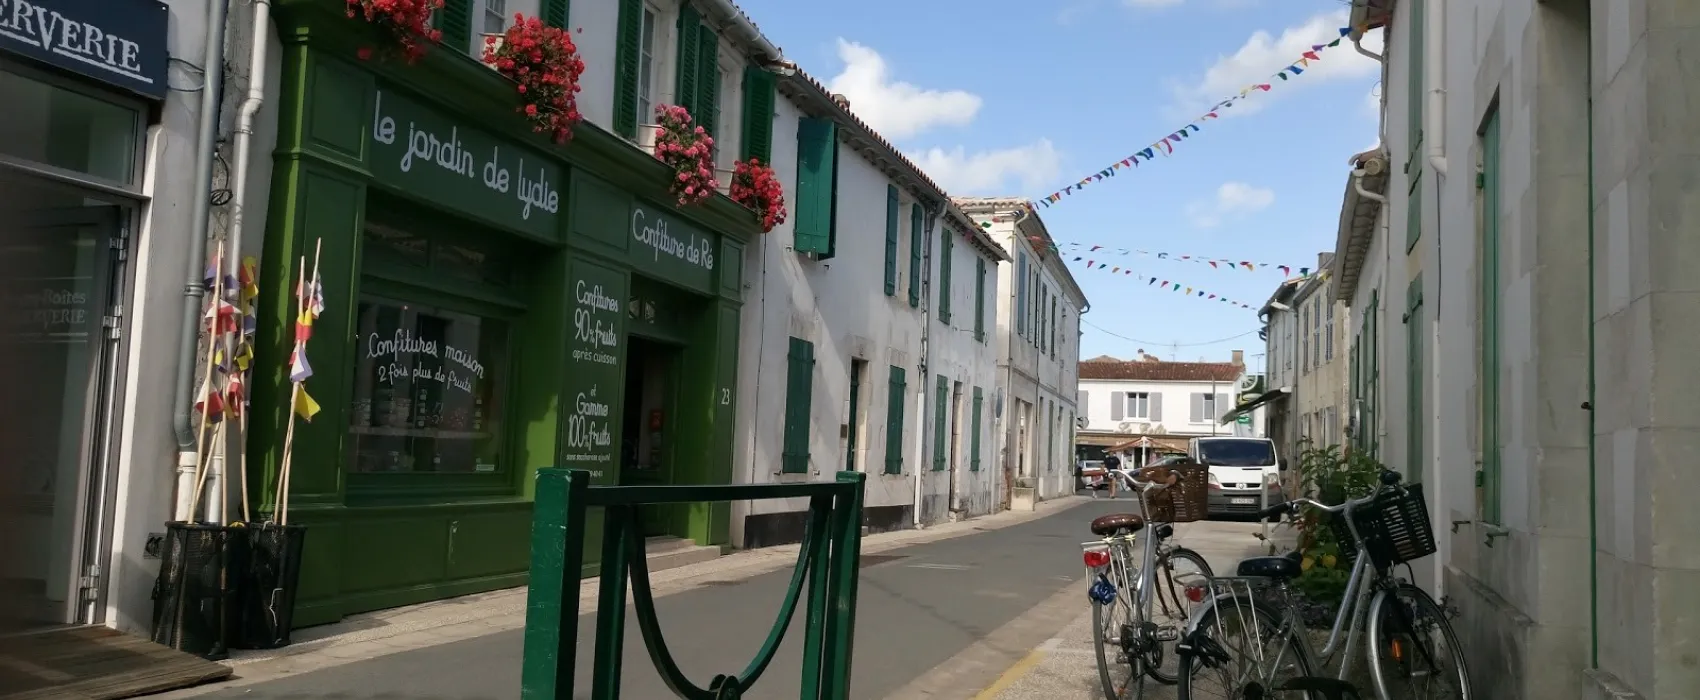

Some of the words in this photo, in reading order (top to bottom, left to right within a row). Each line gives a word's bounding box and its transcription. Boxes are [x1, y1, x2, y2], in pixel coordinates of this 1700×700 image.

[400, 121, 475, 178] jardin
[483, 146, 510, 193] de
[517, 158, 559, 220] lydie
[632, 208, 685, 262] Confiture
[686, 233, 699, 265] de
[701, 238, 714, 270] Ré
[576, 280, 619, 314] Confitures
[594, 320, 617, 349] fruits
[367, 328, 438, 362] Confitures
[445, 345, 484, 379] maison
[572, 347, 592, 363] après
[593, 351, 617, 365] cuisson
[378, 365, 387, 382] 2
[389, 362, 408, 385] fois
[412, 361, 433, 384] plus
[434, 365, 445, 383] de
[447, 370, 472, 393] fruits
[590, 383, 597, 397] et
[576, 392, 608, 417] Gamme
[721, 387, 730, 406] 23
[589, 421, 610, 452] fruits
